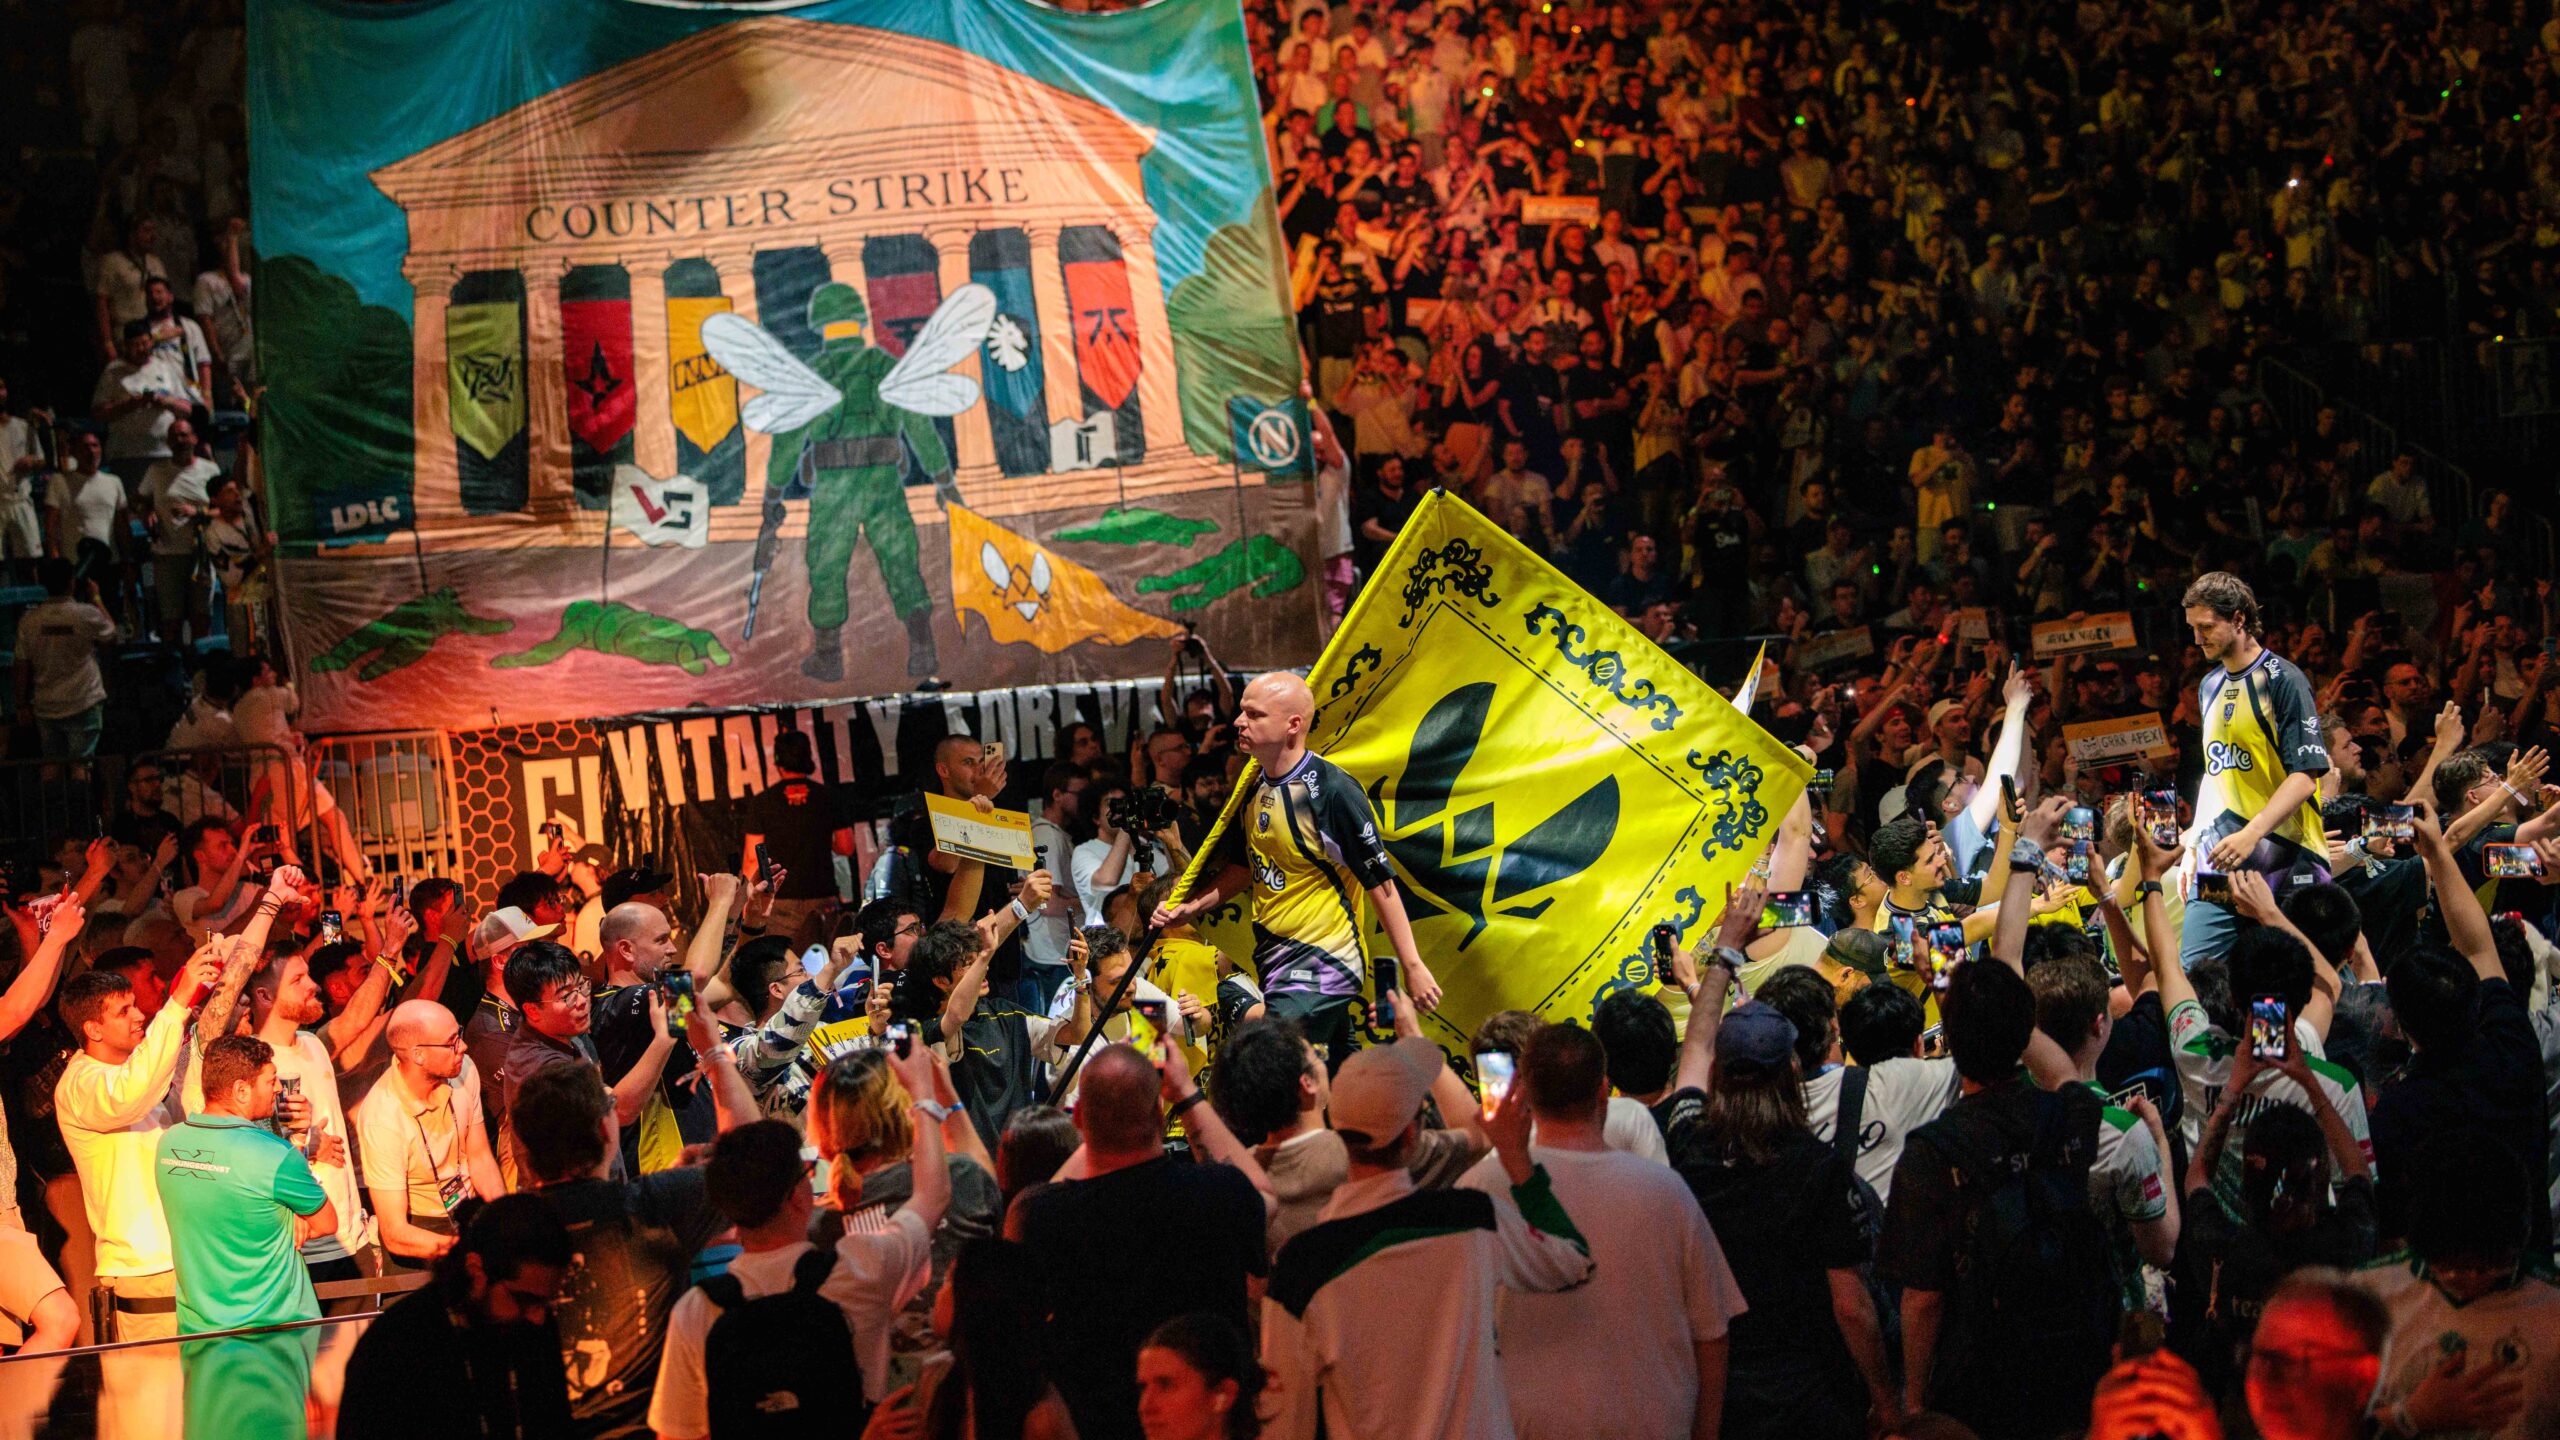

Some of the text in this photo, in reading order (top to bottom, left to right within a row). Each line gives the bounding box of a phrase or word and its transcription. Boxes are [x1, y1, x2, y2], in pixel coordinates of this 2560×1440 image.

[526, 168, 1029, 243] COUNTER-STRIKE
[331, 496, 400, 534] LDLC
[2207, 741, 2252, 776] Stake
[1301, 770, 1319, 799] Stake
[160, 1158, 231, 1174] ORDNUNGSDIENST
